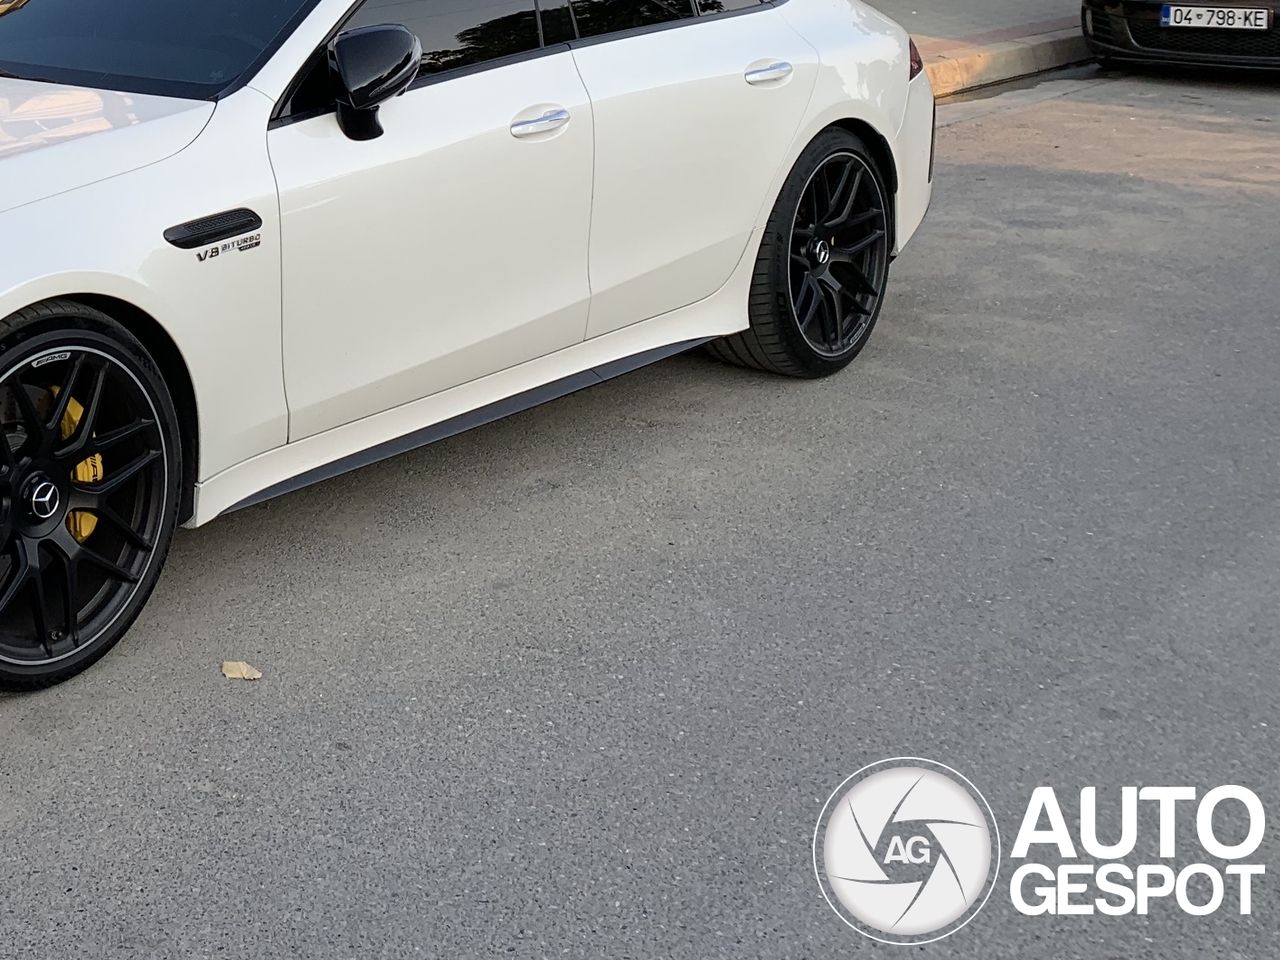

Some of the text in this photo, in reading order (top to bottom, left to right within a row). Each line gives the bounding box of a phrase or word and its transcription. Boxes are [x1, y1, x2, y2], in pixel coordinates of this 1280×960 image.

[1173, 8, 1193, 25] 04
[196, 234, 261, 262] V8 BITURBO
